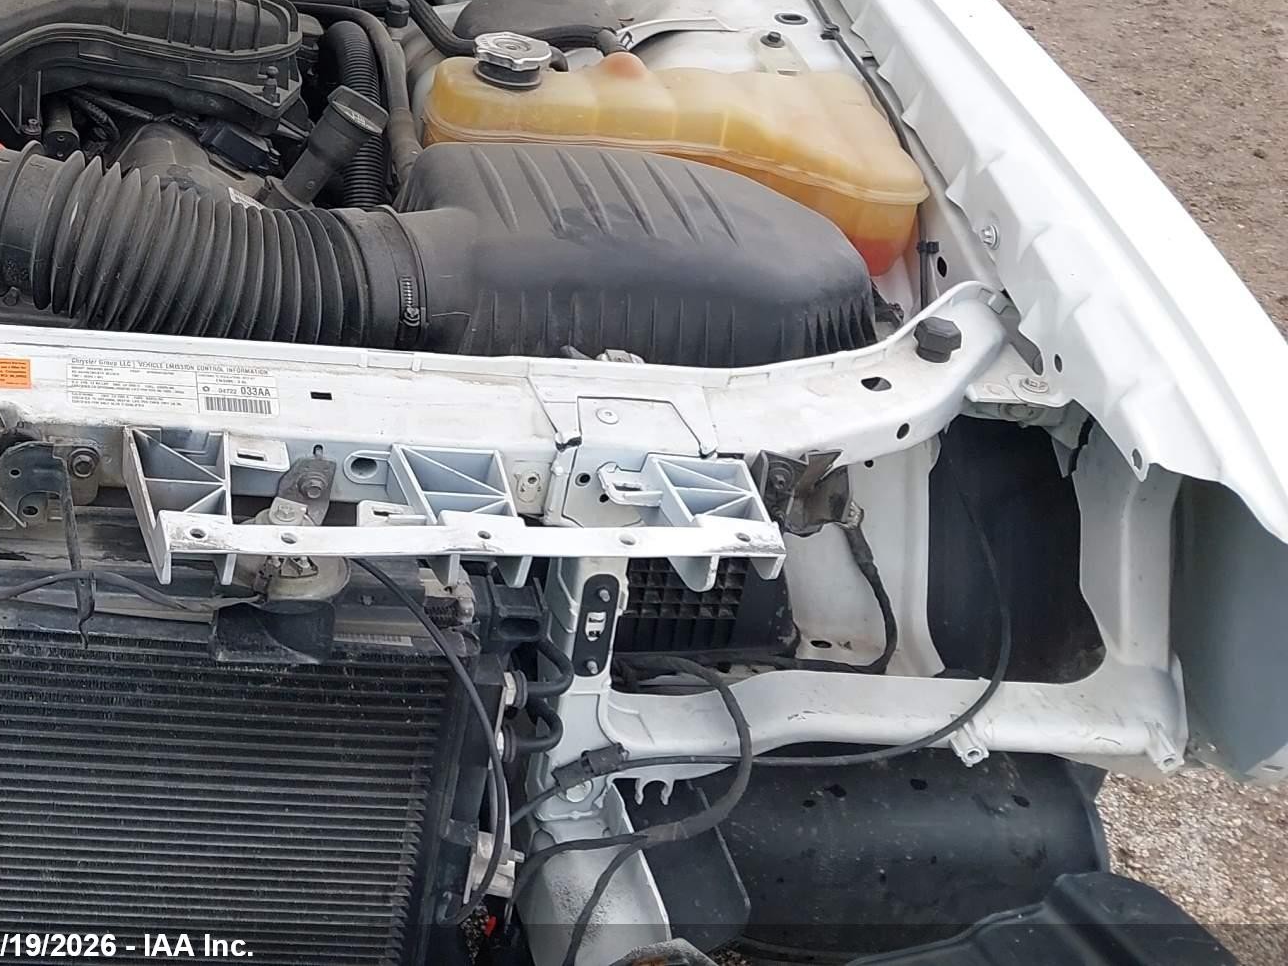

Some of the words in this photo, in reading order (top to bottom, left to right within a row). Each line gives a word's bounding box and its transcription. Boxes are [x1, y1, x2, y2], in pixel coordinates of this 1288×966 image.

[120, 359, 132, 367] LLC
[139, 360, 164, 369] VEHICLE
[227, 366, 269, 375] INFORMATION
[241, 386, 271, 397] 033AA
